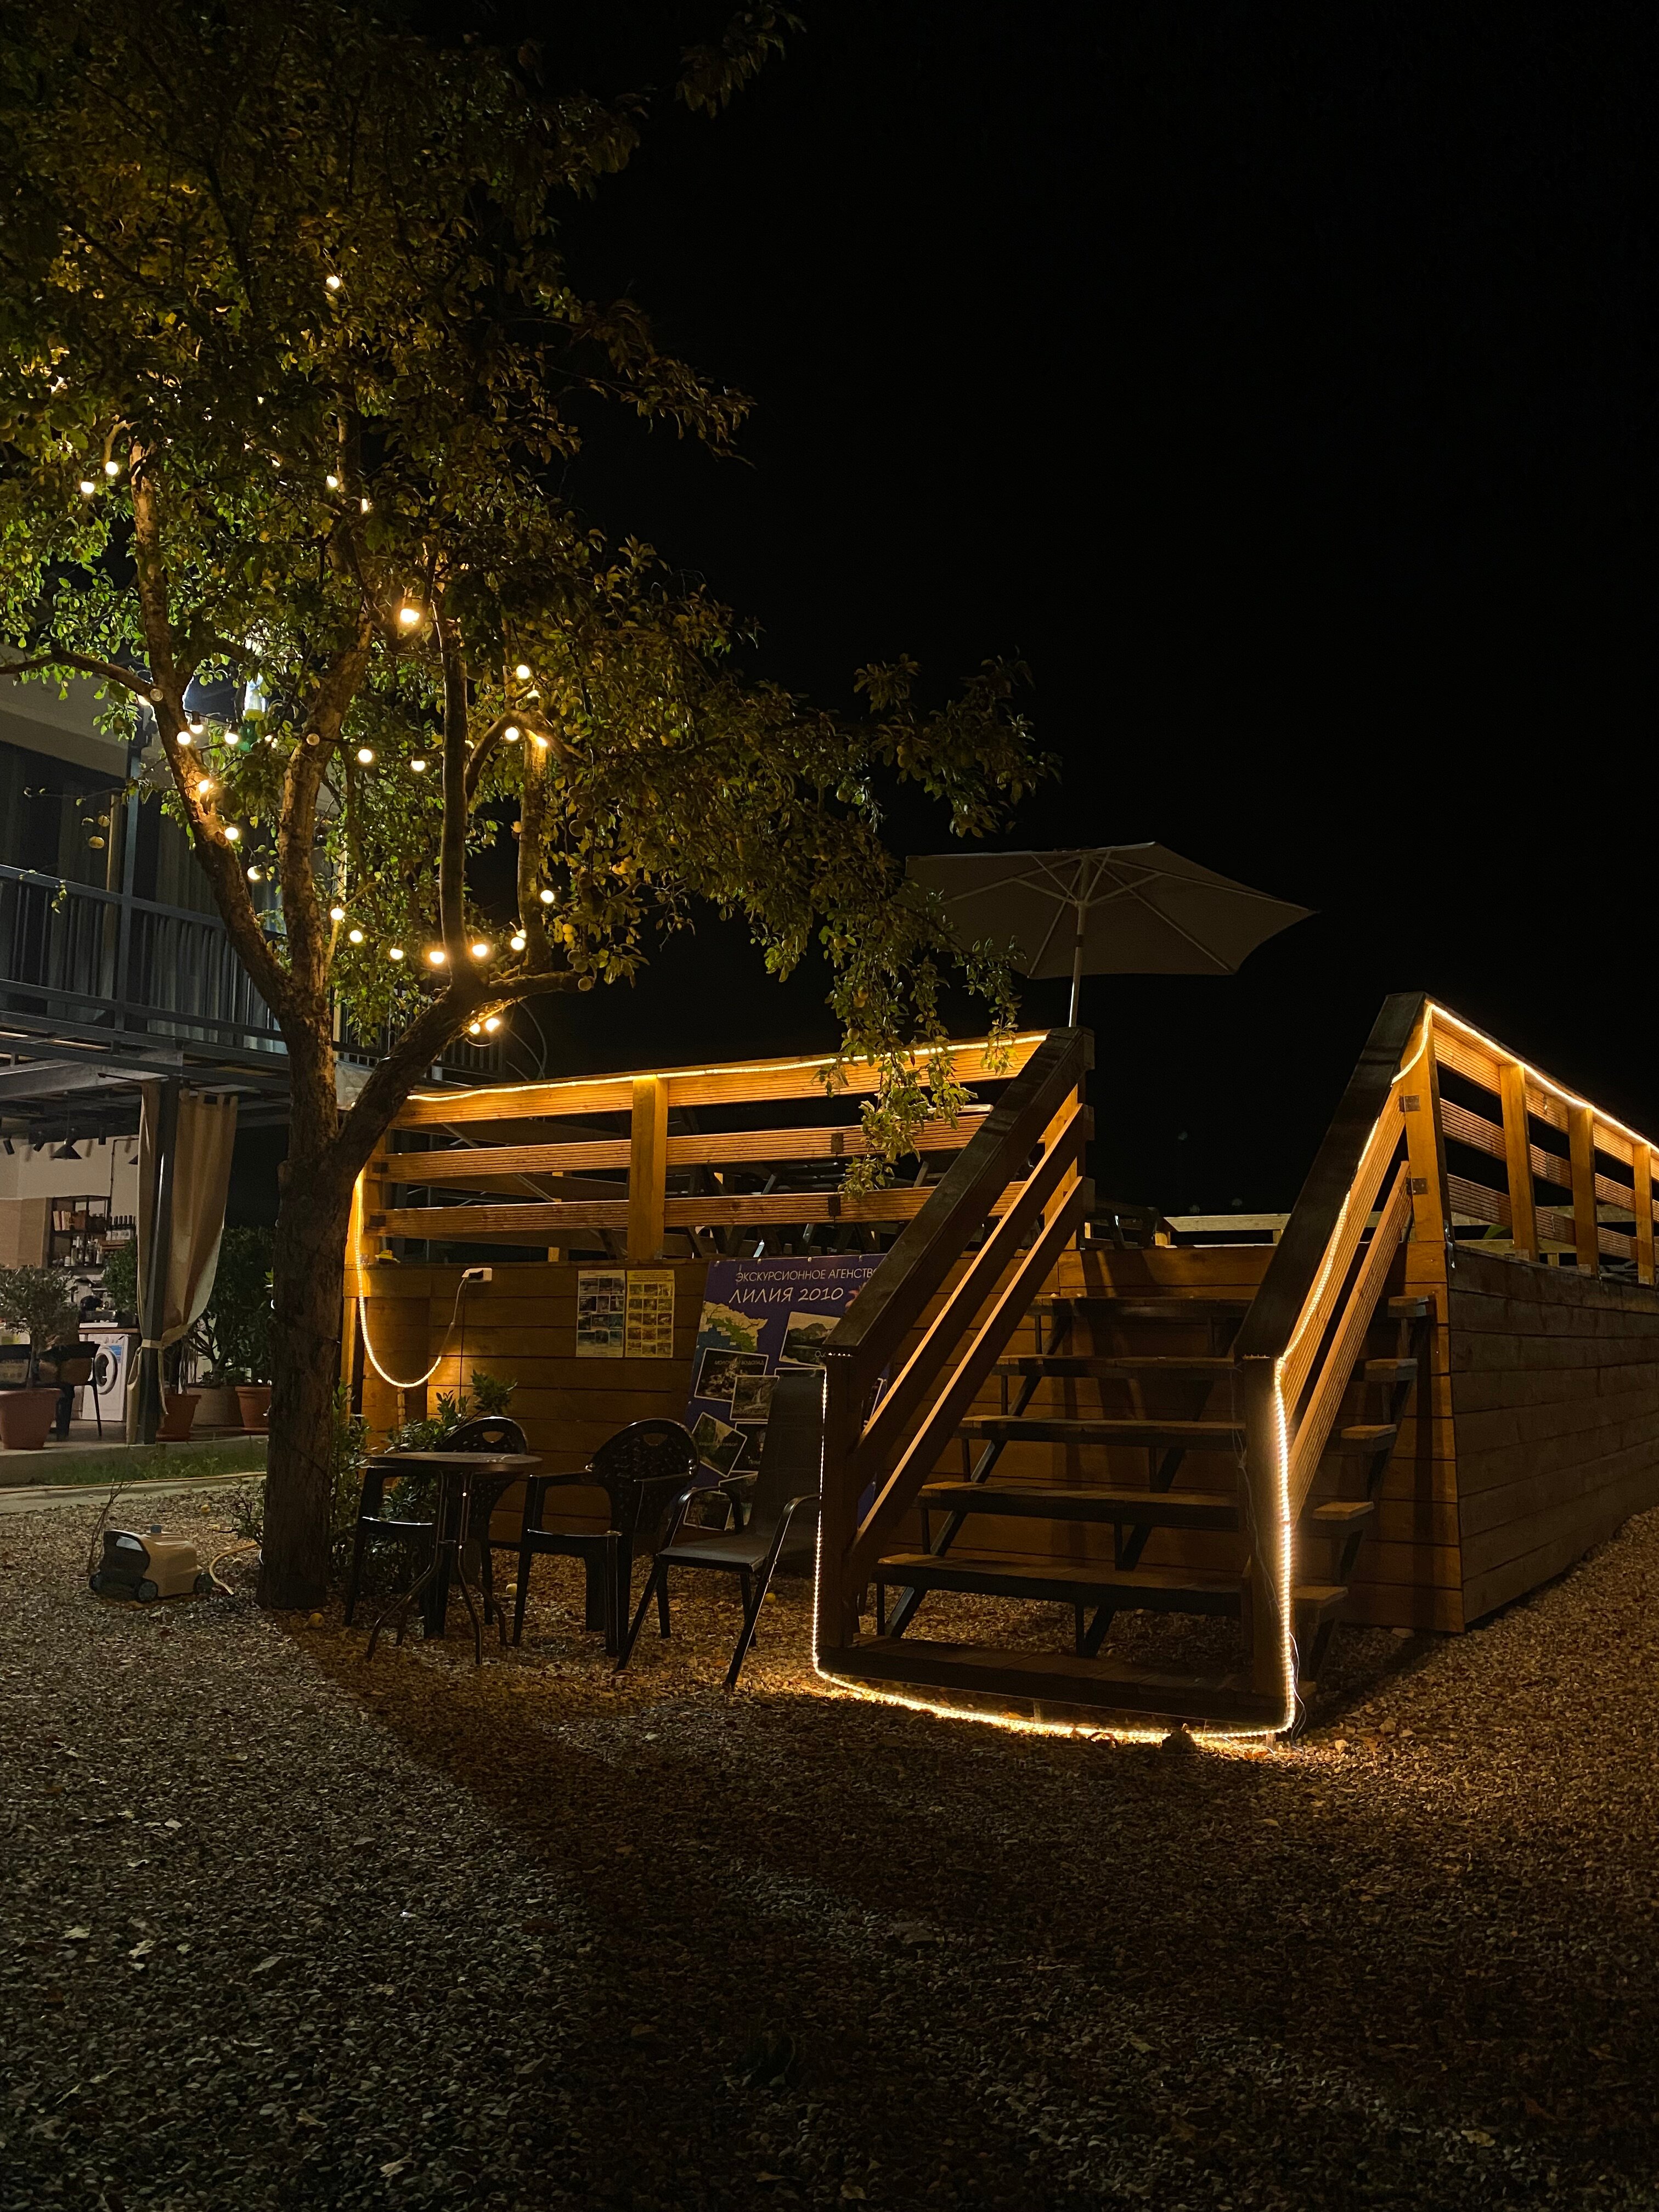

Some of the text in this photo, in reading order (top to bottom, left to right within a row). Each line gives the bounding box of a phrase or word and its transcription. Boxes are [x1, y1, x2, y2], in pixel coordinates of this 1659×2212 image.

[735, 1269, 826, 1283] ЭКСКУРСИОННОЕ
[729, 1286, 844, 1304] ЛИЛИЯ 2010
